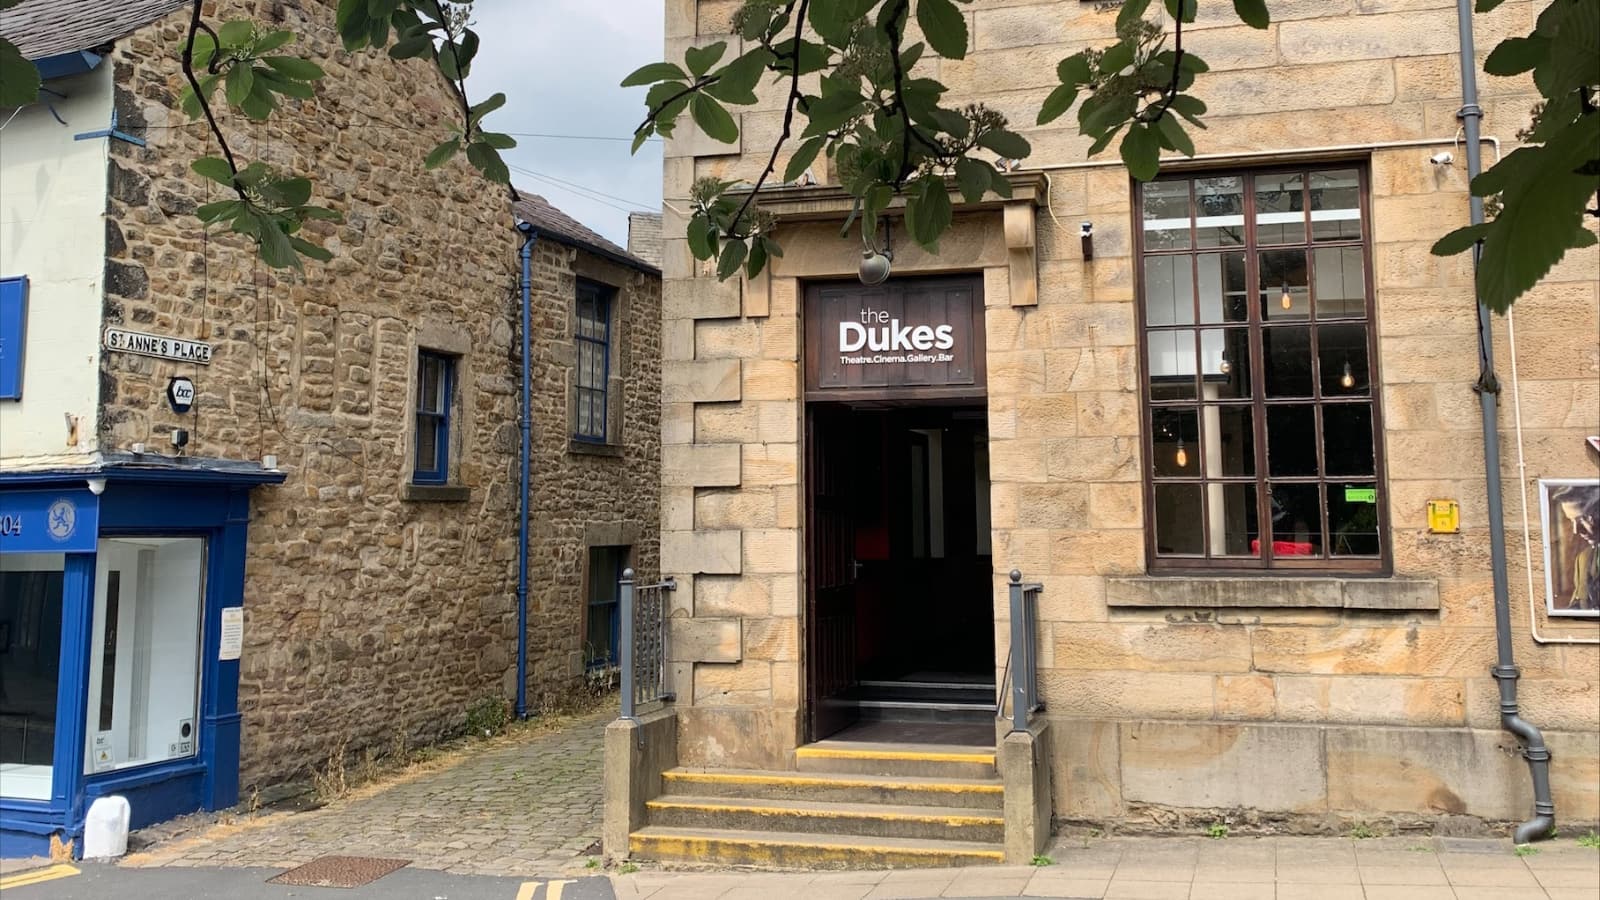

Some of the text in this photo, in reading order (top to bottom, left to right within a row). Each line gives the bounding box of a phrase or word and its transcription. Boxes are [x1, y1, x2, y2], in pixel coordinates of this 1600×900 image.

[860, 306, 889, 324] the
[127, 335, 168, 354] ANNE'S
[173, 342, 209, 360] PLACE
[839, 319, 954, 352] Dukes
